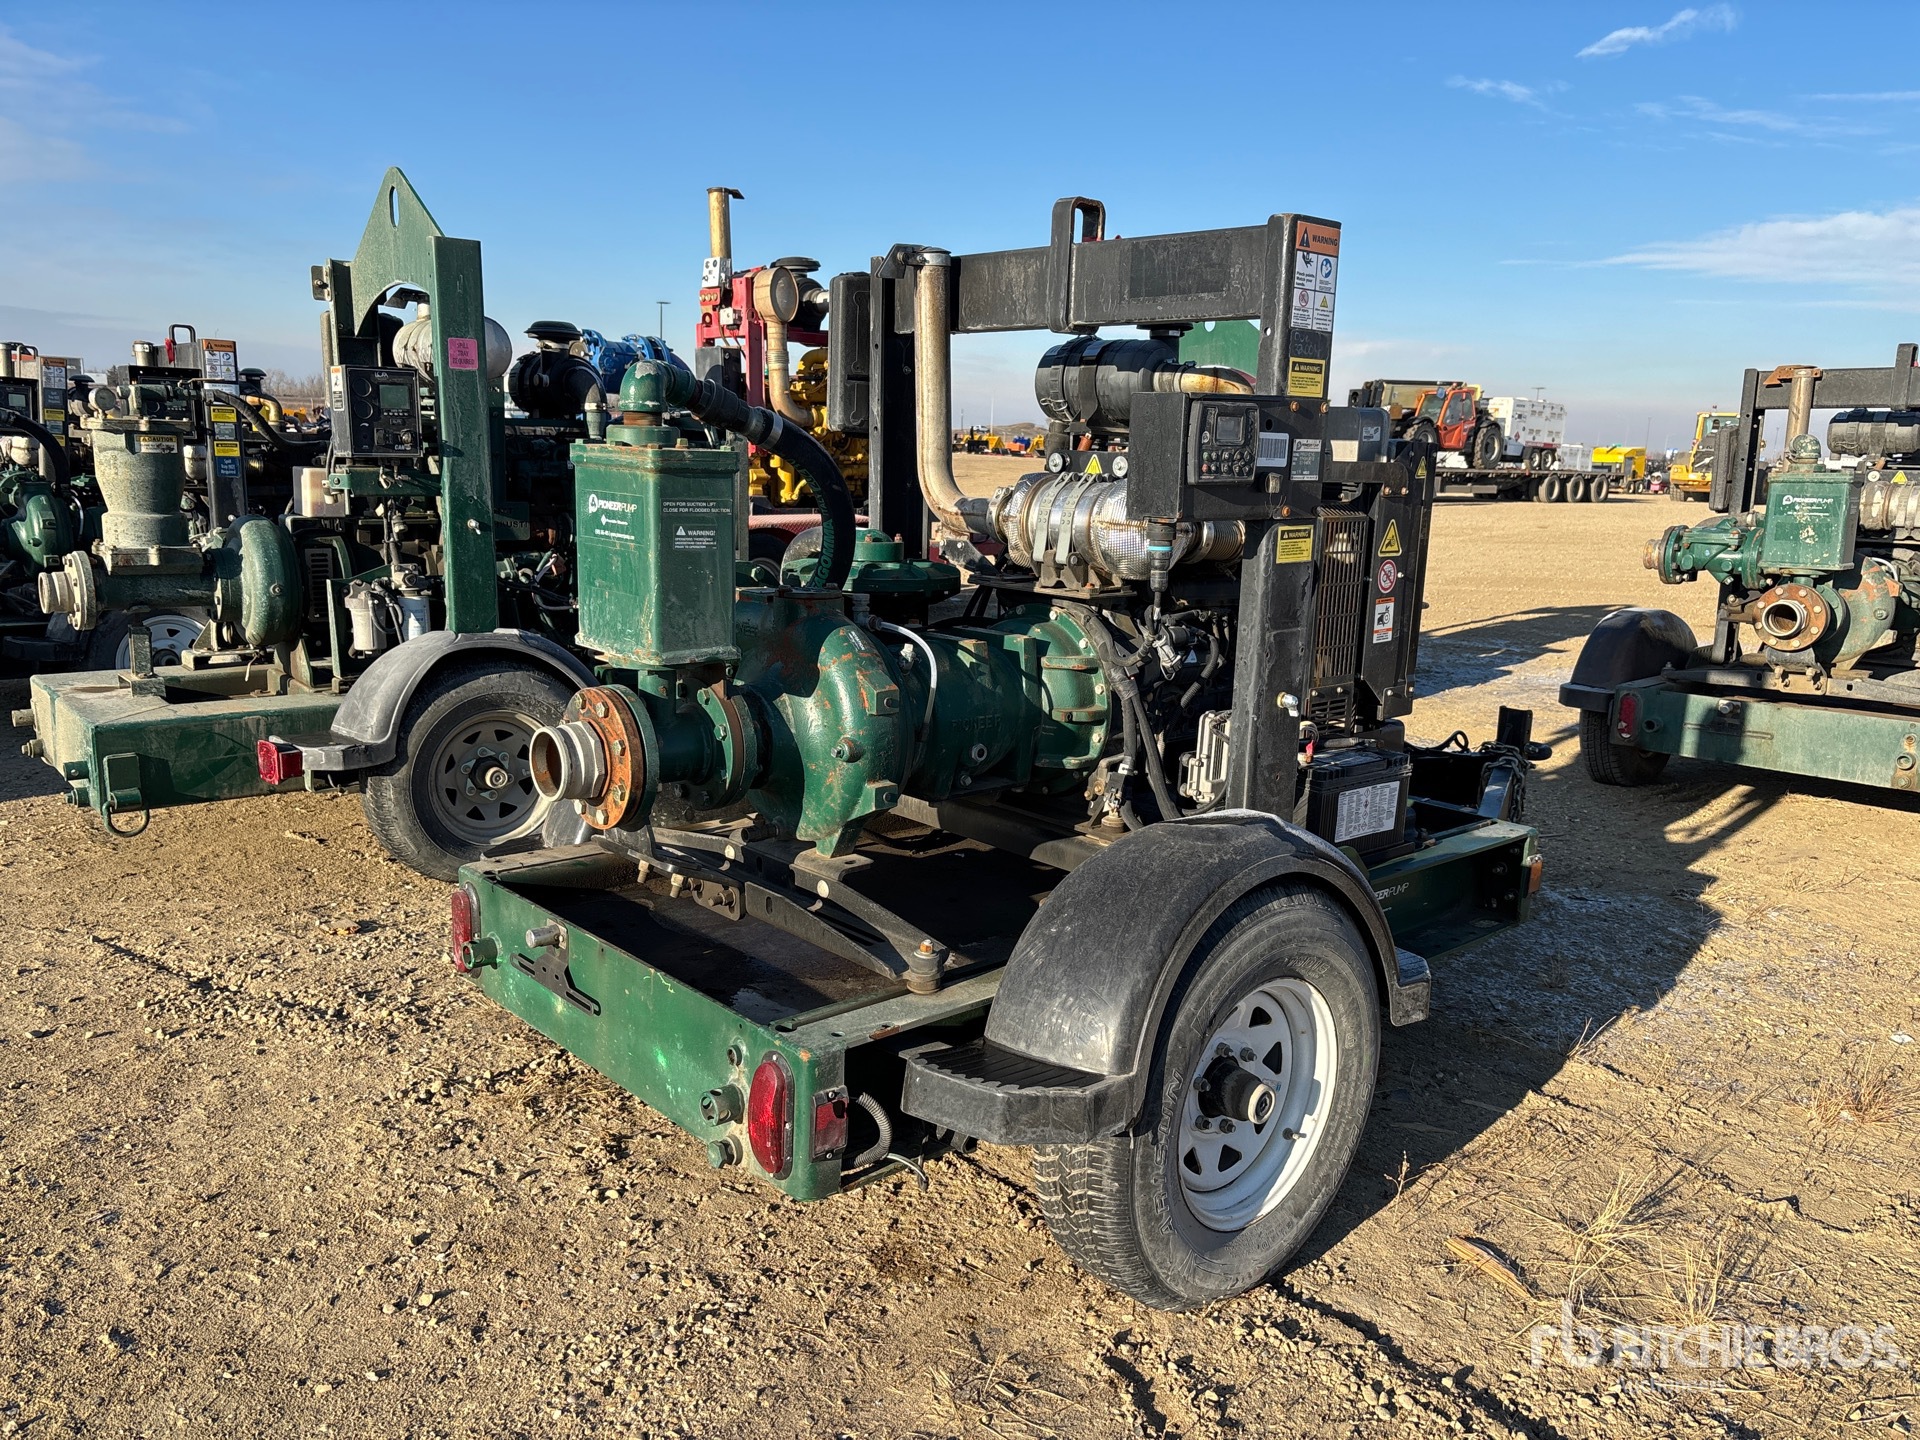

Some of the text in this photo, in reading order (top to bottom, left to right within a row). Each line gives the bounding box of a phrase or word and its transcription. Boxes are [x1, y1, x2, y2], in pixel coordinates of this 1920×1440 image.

[1312, 234, 1338, 247] WARNING
[1299, 364, 1321, 372] WARNING
[1374, 882, 1410, 900] EERPUMP
